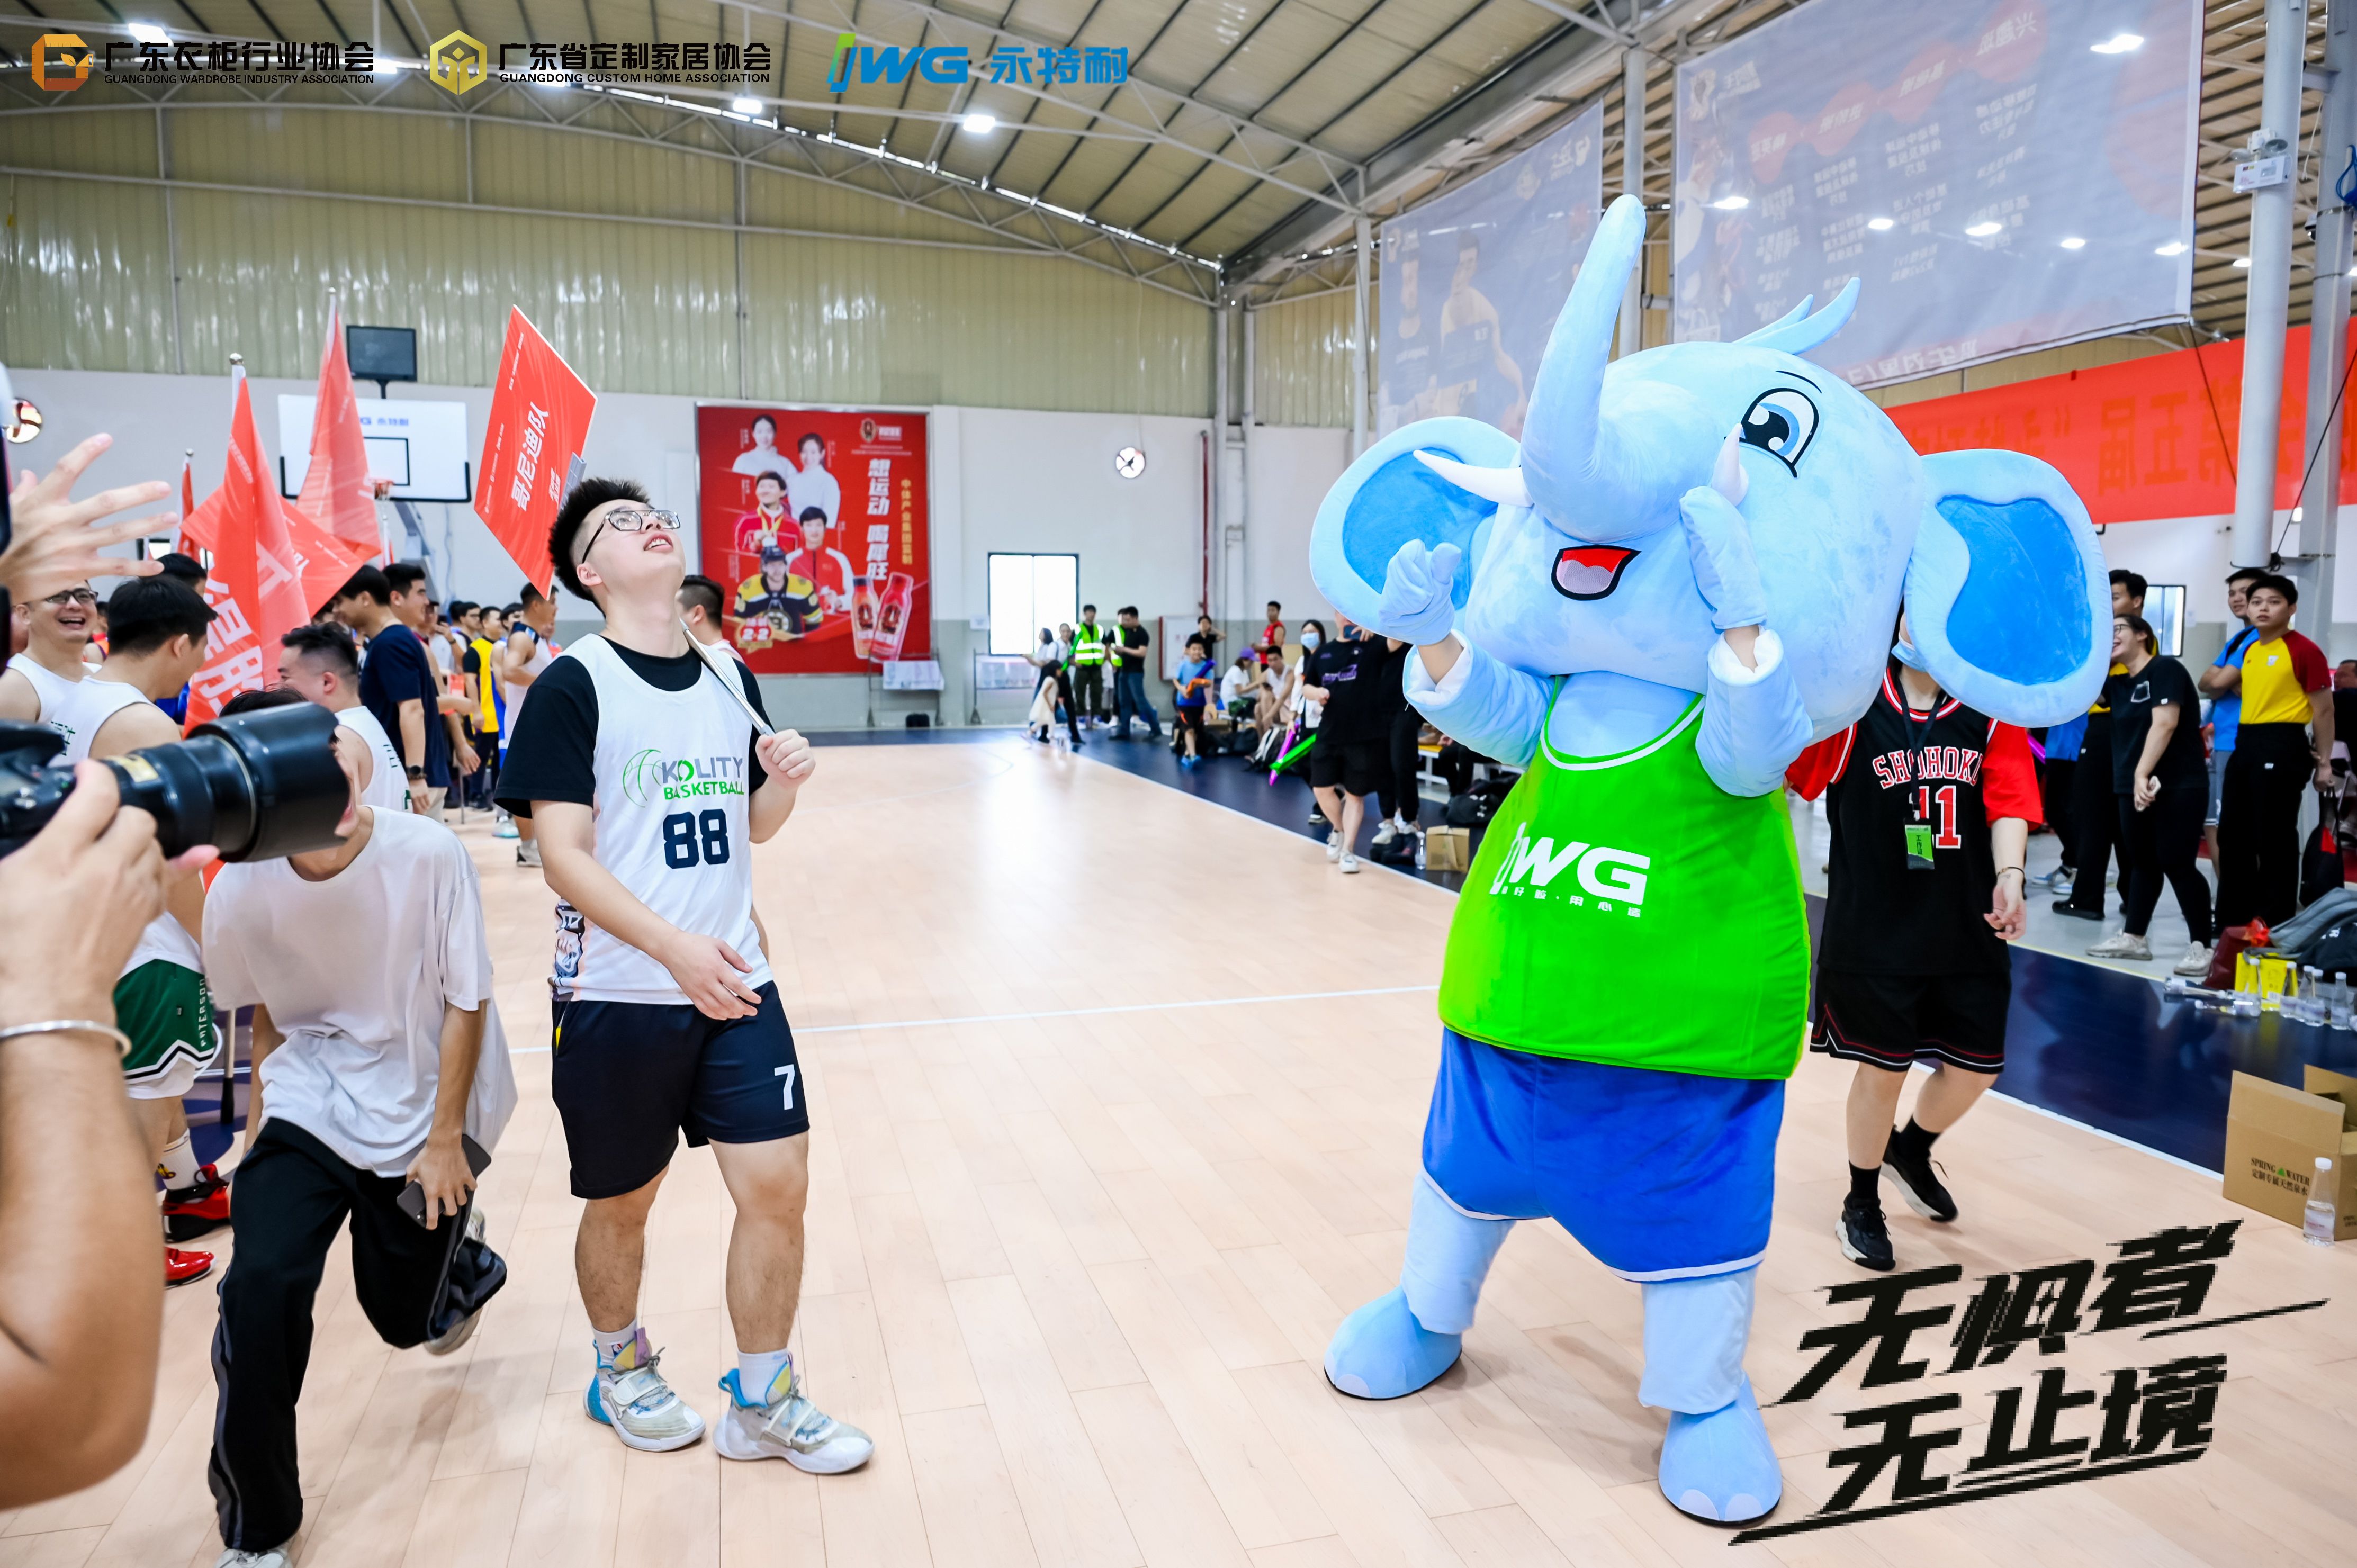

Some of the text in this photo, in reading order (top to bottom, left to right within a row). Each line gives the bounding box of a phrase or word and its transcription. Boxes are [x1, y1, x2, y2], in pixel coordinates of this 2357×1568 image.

[510, 401, 550, 512] 哥尼迪队
[662, 756, 743, 784] KOLITY
[663, 781, 744, 800] BASKETBALL
[663, 809, 730, 869] 88
[198, 978, 208, 1047] PATERSON
[773, 1064, 796, 1111] 7
[2251, 1157, 2310, 1186] SPRING WATER
